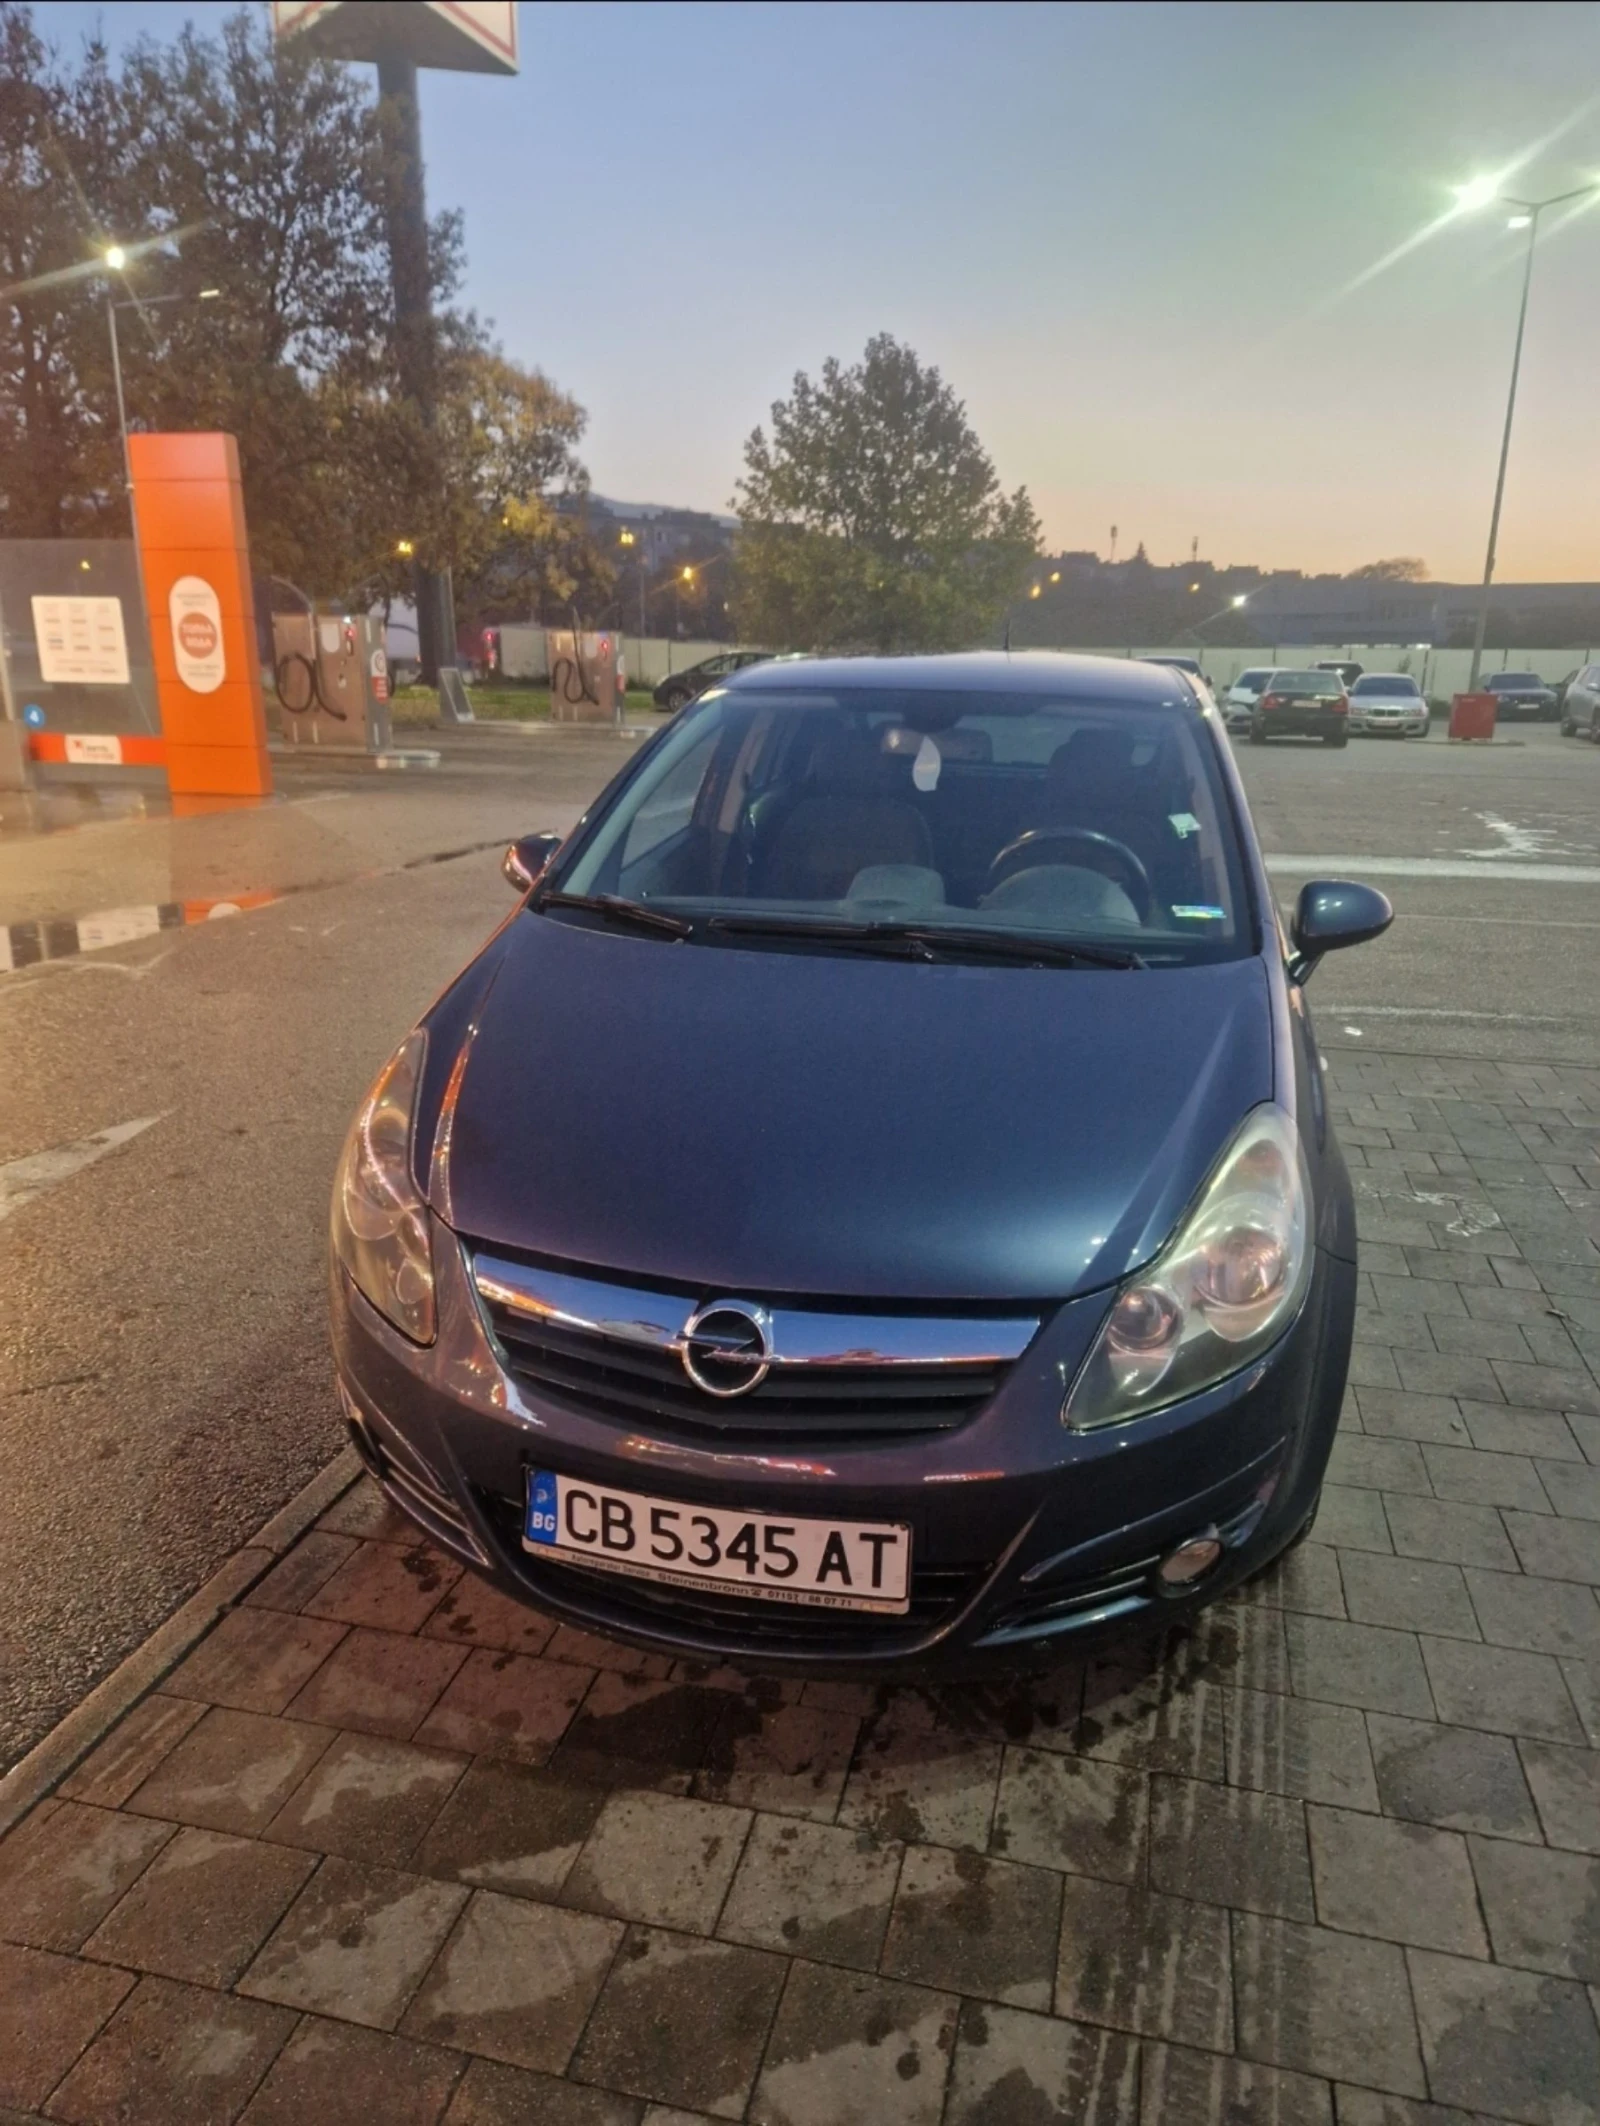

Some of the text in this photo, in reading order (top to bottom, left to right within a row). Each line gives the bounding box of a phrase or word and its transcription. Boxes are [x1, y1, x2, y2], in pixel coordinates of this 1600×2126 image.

[532, 1511, 555, 1532] BG
[565, 1489, 898, 1588] CB 5345 AT
[657, 1572, 749, 1595] Steinenbronn
